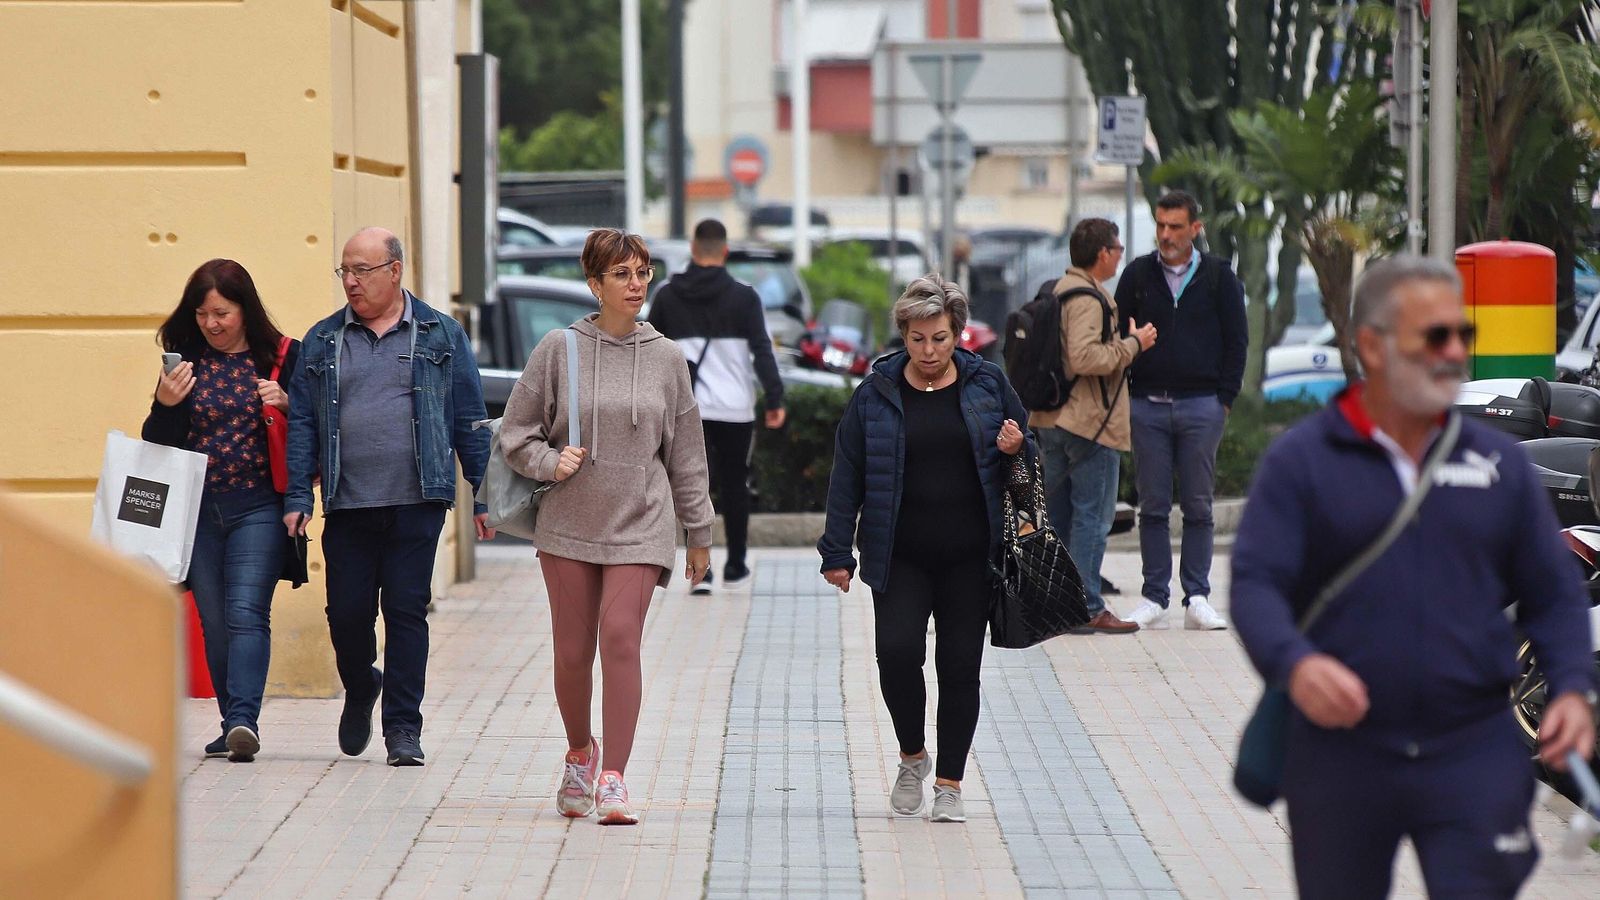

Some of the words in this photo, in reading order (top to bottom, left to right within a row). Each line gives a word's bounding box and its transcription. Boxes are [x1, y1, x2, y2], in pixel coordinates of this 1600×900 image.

[1498, 408, 1513, 416] 37
[129, 489, 155, 500] MARKS
[125, 496, 162, 510] SPENCER
